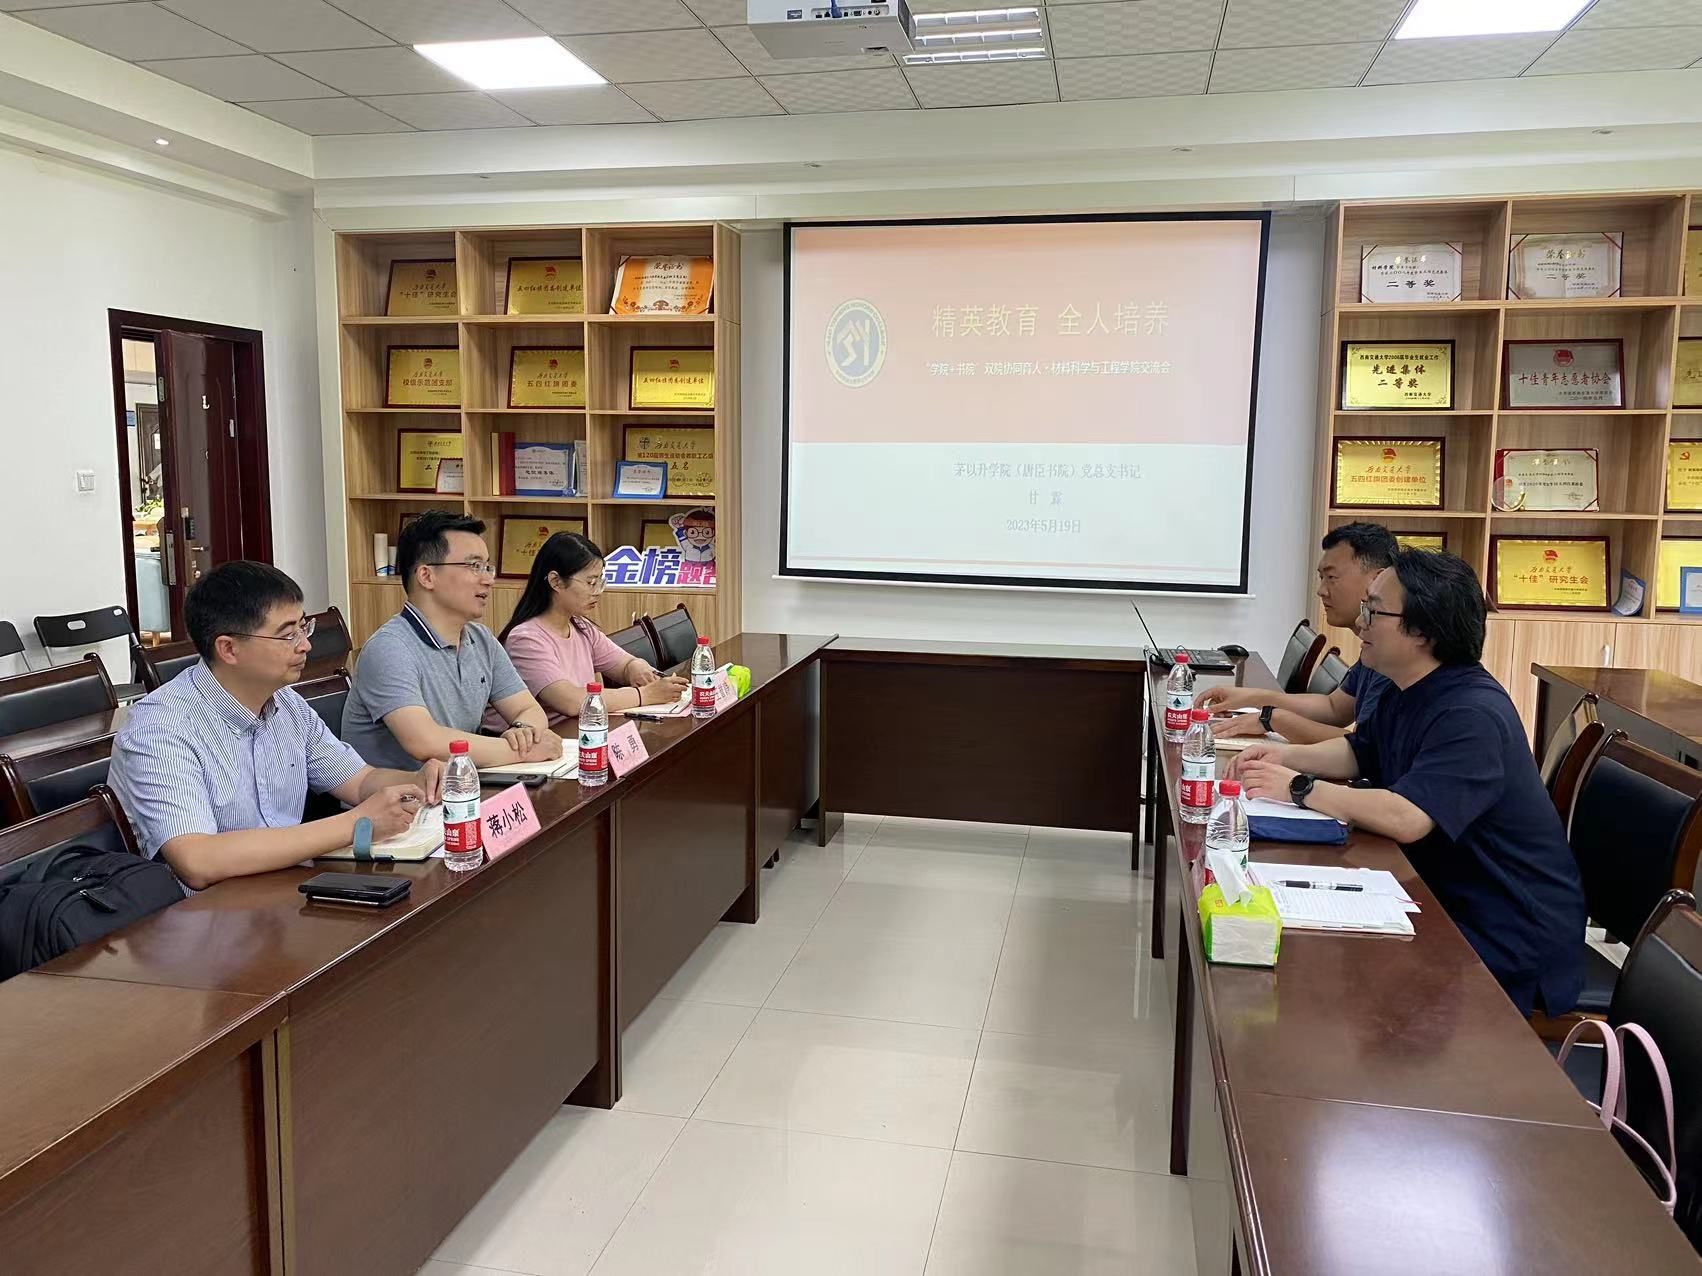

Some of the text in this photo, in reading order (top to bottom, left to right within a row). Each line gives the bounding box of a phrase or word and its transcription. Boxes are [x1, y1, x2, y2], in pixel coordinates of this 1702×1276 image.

[1386, 279, 1436, 289] 二等奖
[932, 302, 1169, 338] 精英教育 全人培养
[1372, 364, 1426, 375] 先进集体
[1378, 378, 1418, 389] 二等奖
[1519, 372, 1611, 386] 十佳青年志愿者协会
[1006, 519, 1081, 534] 2023年5月19日
[1514, 574, 1589, 584] “十佳”研究生会
[486, 802, 528, 838] 蒋小松
